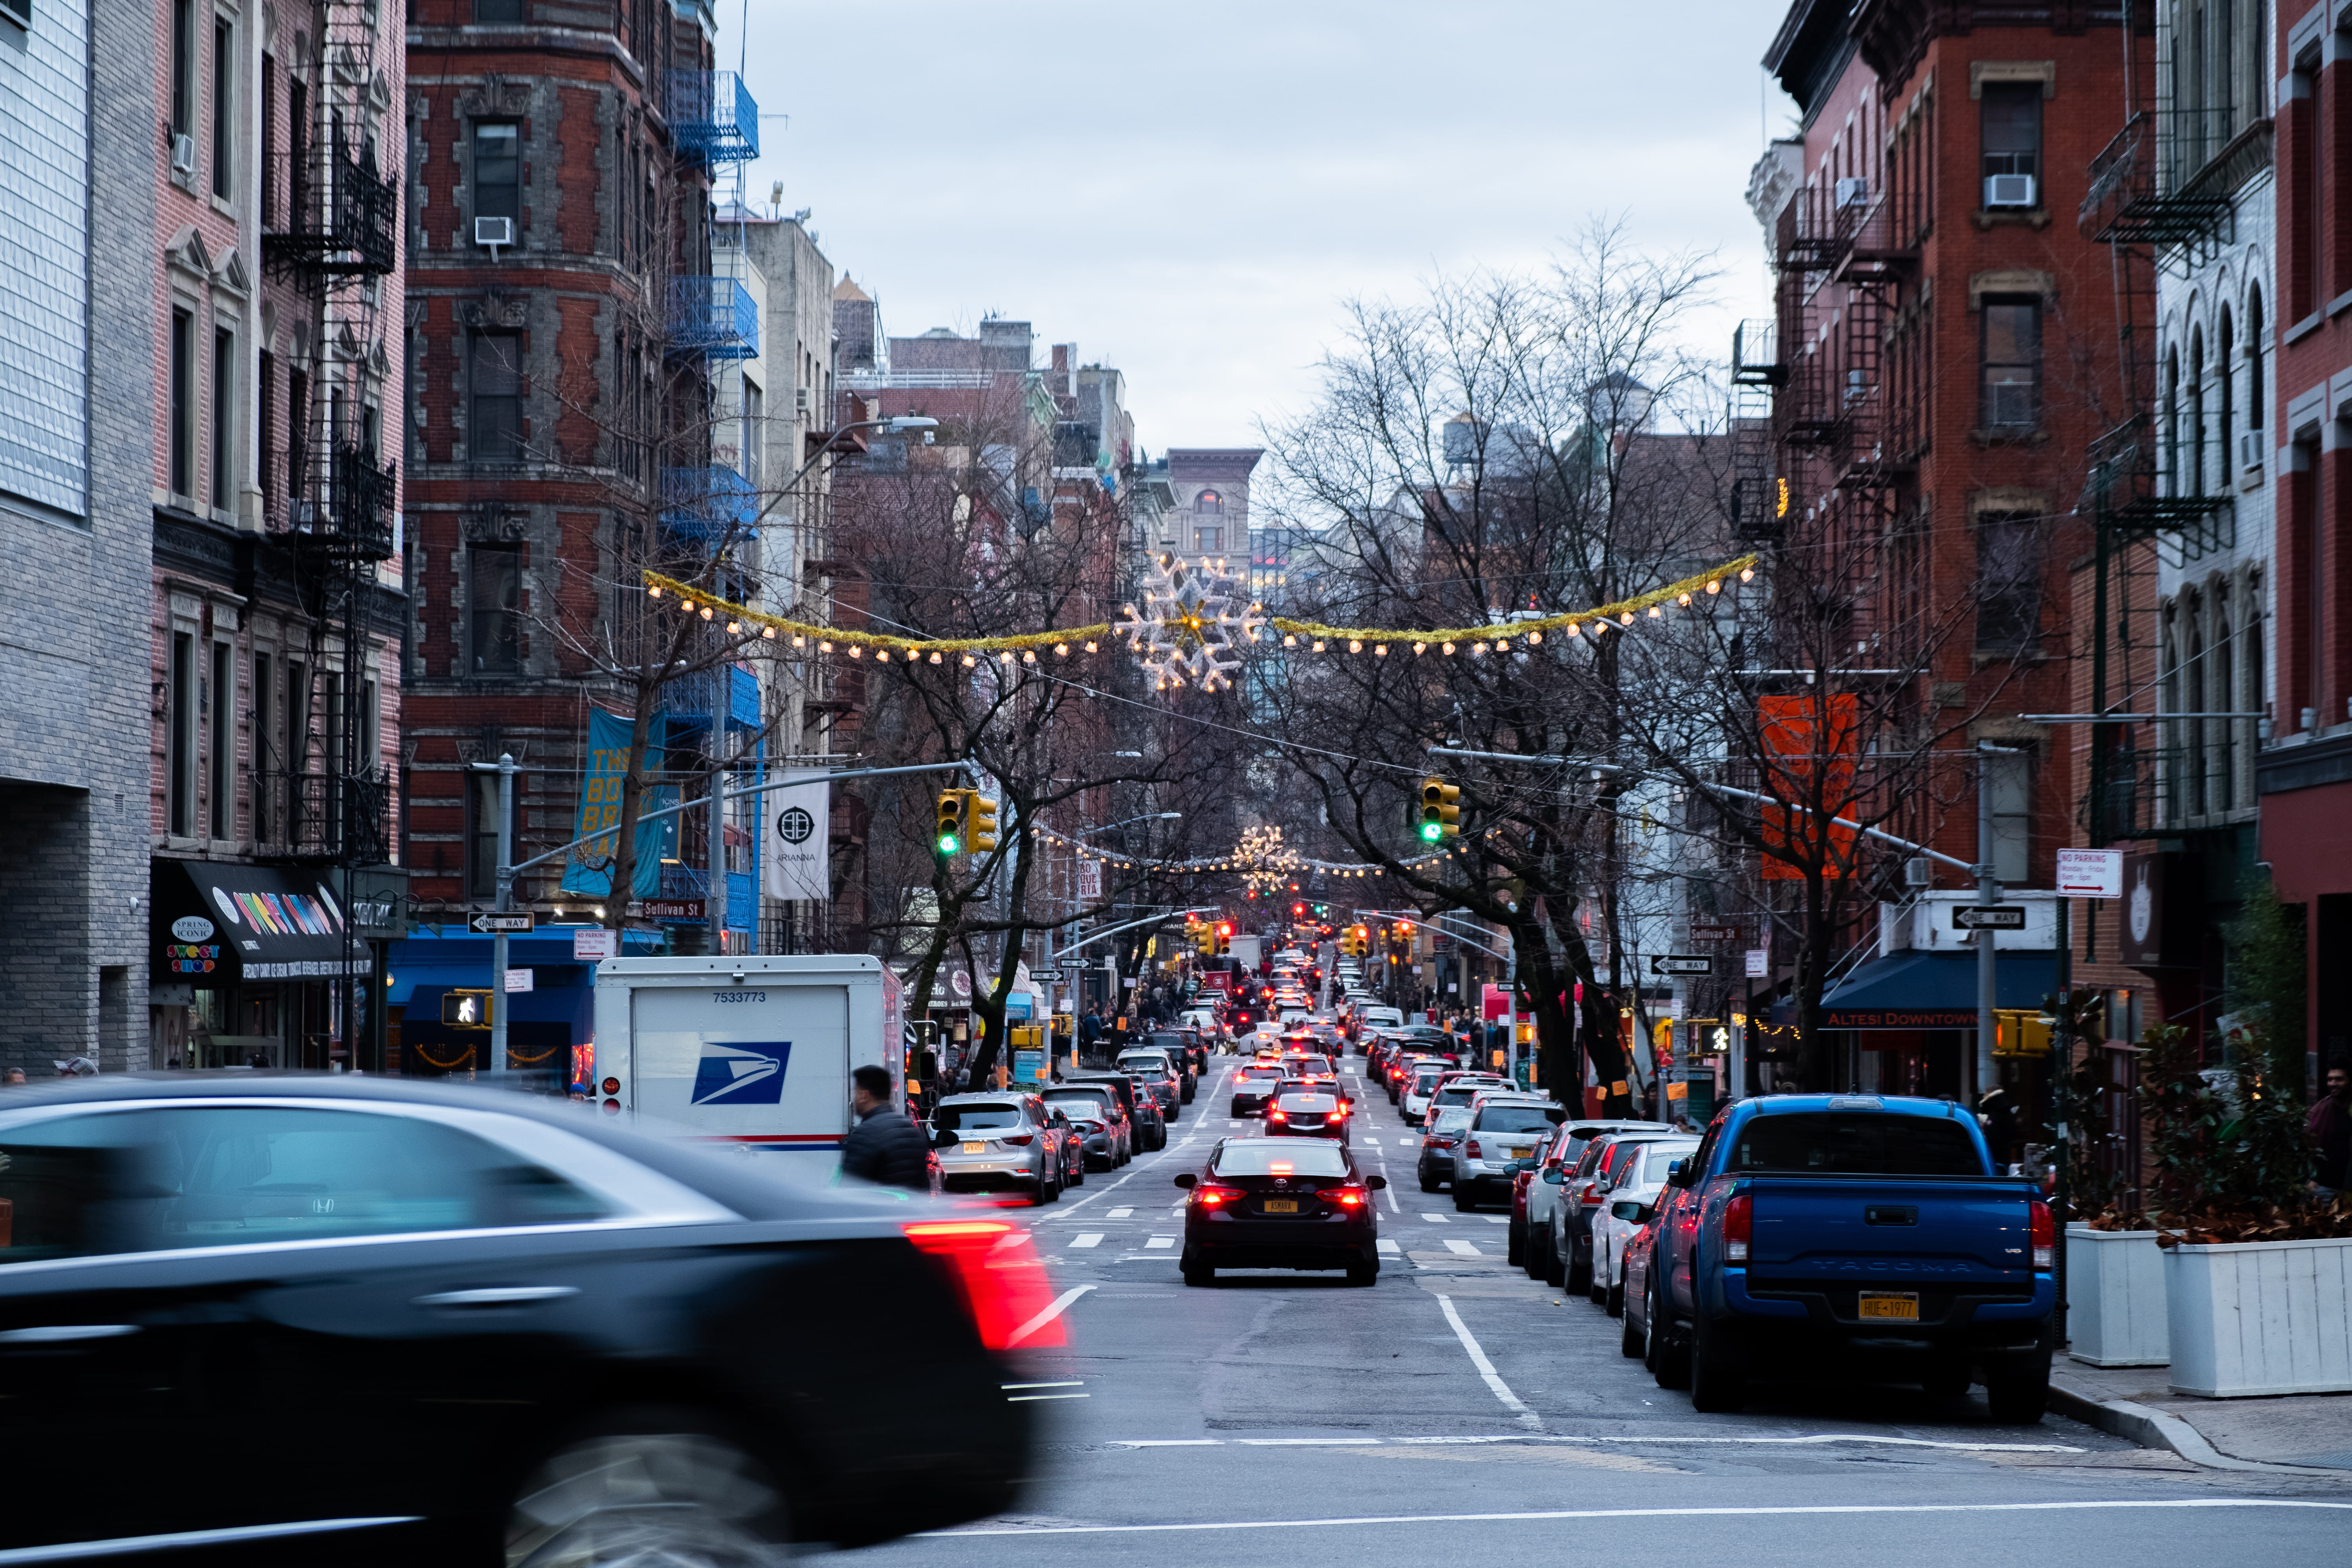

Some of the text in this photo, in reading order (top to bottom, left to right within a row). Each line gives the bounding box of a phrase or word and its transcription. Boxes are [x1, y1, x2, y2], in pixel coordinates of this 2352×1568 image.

[2074, 854, 2107, 863] PARKING
[645, 903, 698, 916] Sullivan St
[479, 919, 524, 927] ONE WAY
[1963, 913, 2017, 922] ONE WAY
[1691, 928, 1734, 939] Sullivan St
[172, 960, 215, 973] SHOP
[713, 992, 766, 1003] 7533773
[1828, 1013, 1881, 1025] ALTESI
[1271, 1201, 1291, 1210] ASMARA
[1812, 1260, 1971, 1272] TACOMA
[1864, 1301, 1912, 1316] HUE 1977
